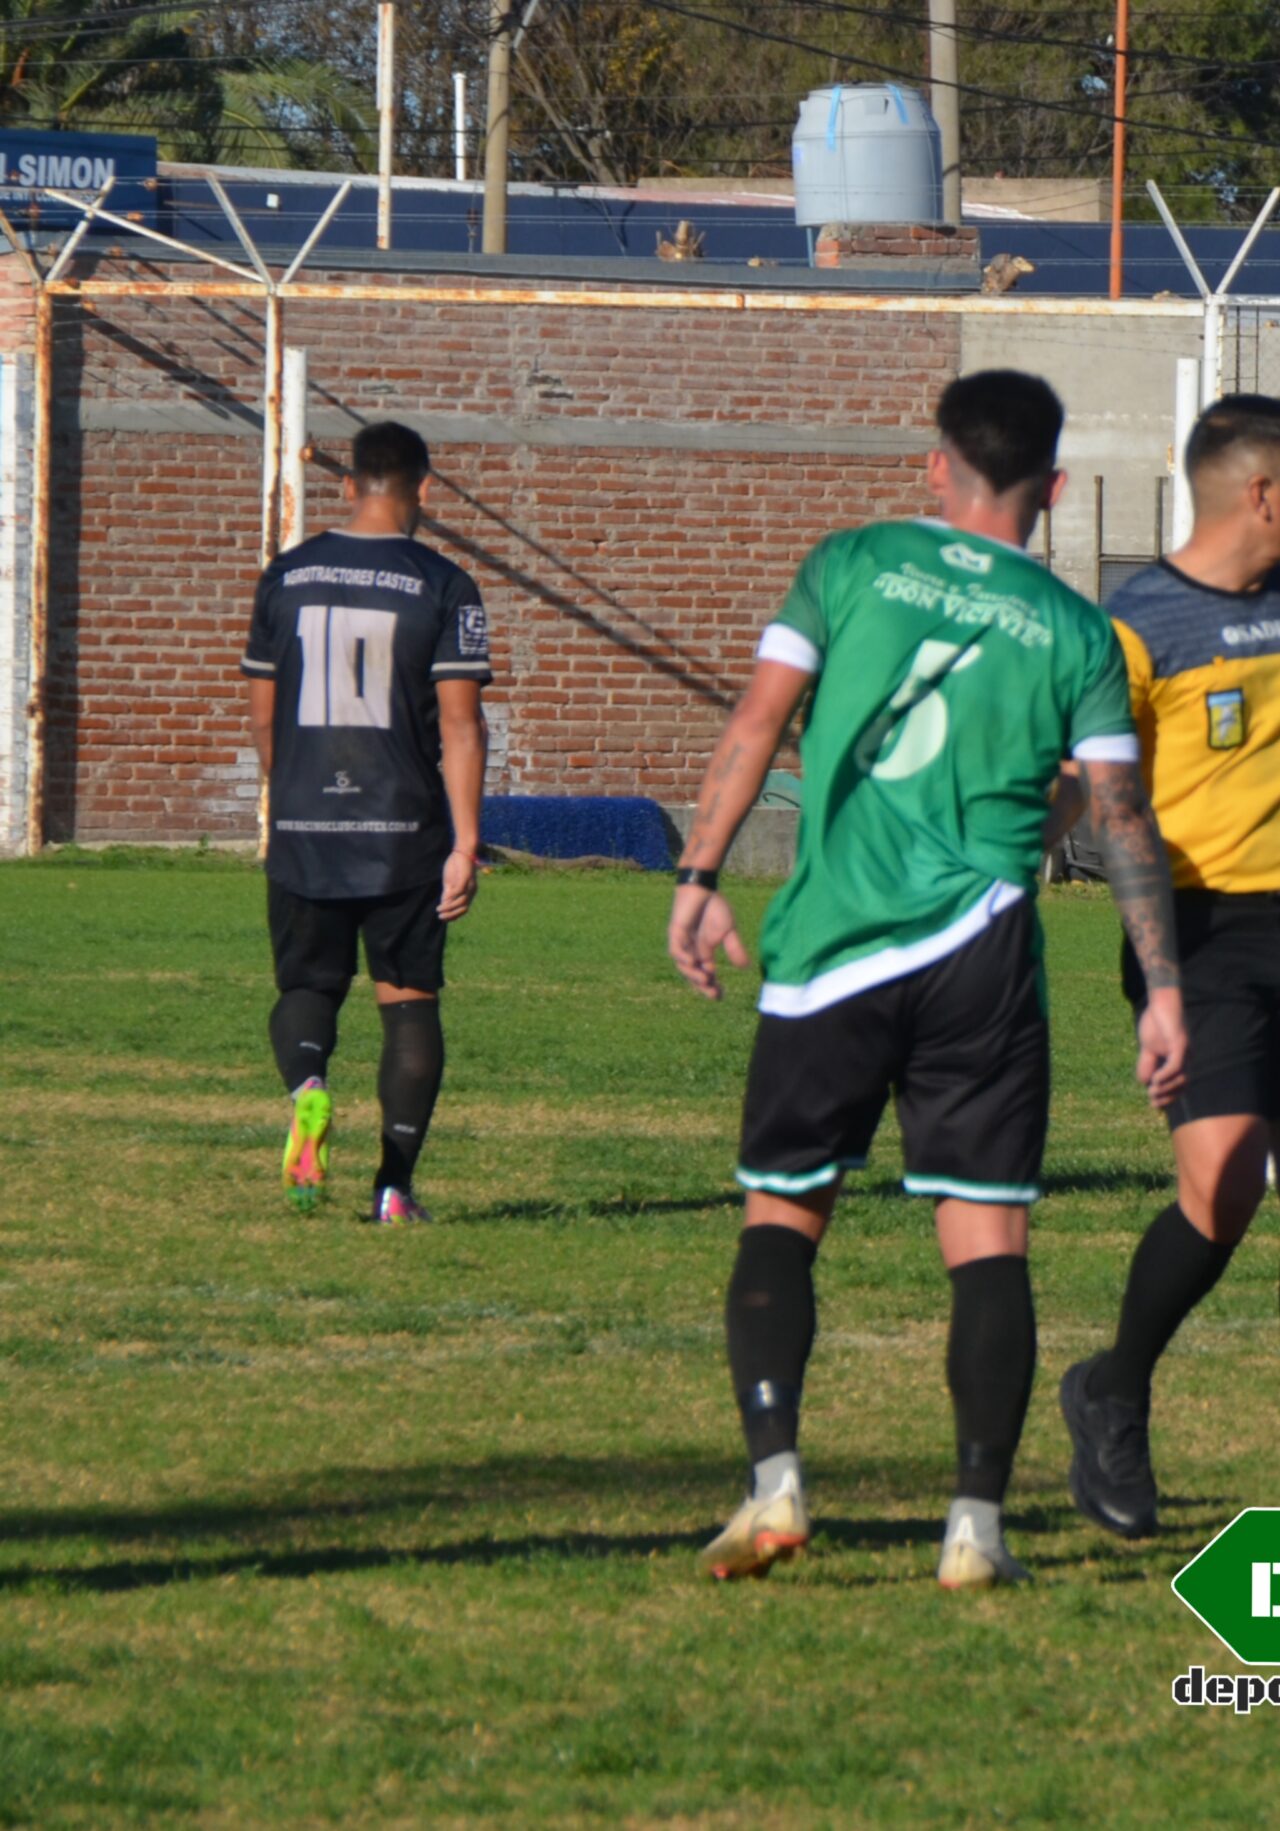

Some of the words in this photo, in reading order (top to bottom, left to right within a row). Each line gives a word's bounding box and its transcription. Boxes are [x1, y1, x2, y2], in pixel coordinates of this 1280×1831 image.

[18, 153, 114, 188] SIMON
[375, 571, 423, 595] CASTEX
[296, 606, 397, 728] 10
